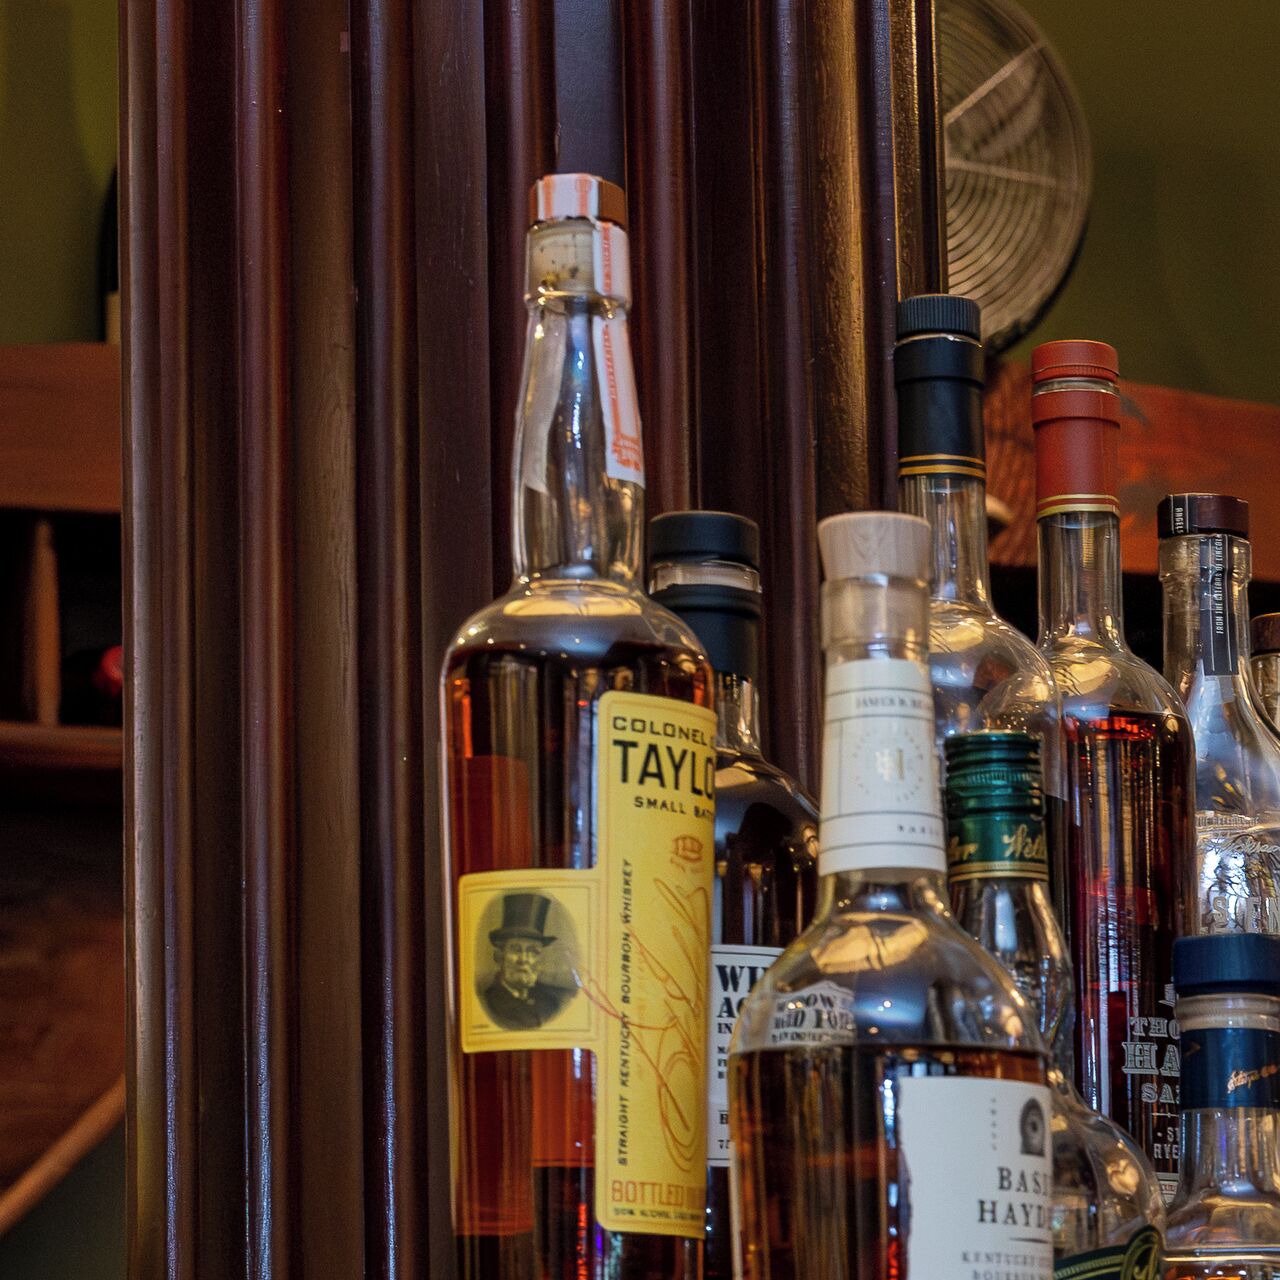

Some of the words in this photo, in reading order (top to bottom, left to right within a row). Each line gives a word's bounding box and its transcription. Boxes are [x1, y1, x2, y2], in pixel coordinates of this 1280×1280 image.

[613, 716, 708, 746] COLONEL
[634, 796, 687, 815] SMALL
[621, 858, 633, 925] WHISKEY
[620, 935, 633, 1004] BOURBON
[620, 1012, 632, 1088] KENTUCKY
[618, 1095, 630, 1167] STRAIGHT
